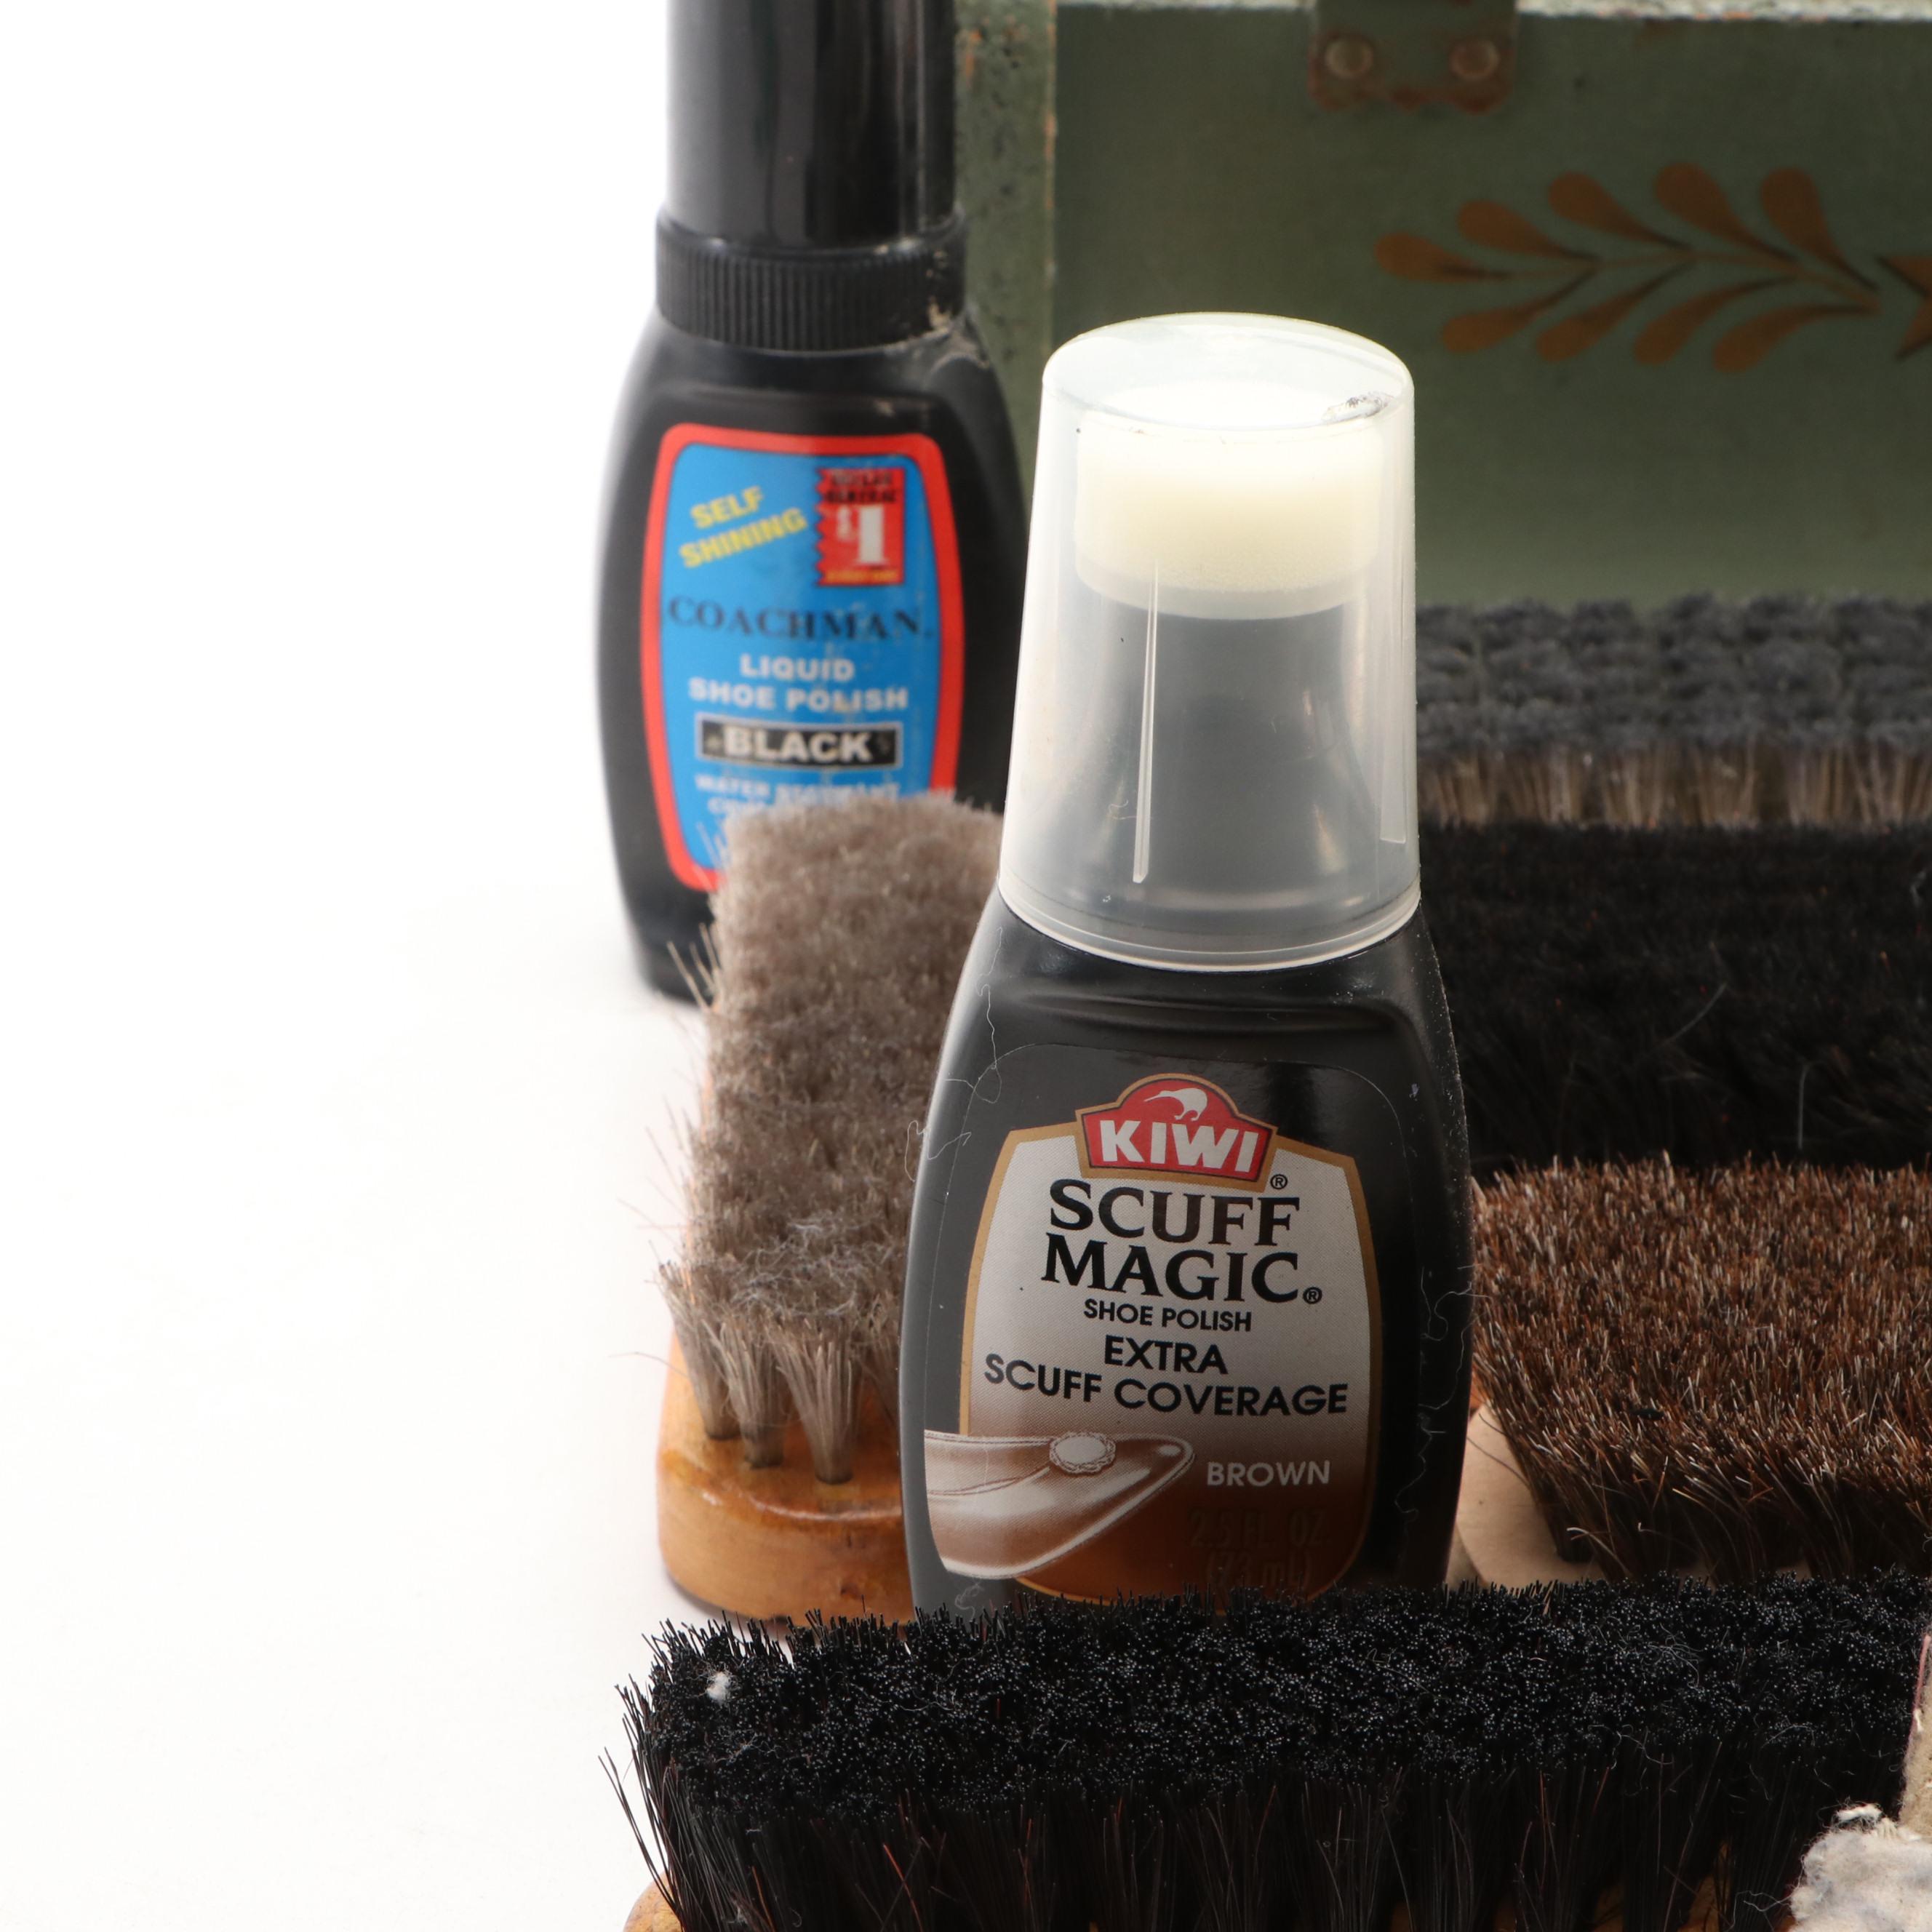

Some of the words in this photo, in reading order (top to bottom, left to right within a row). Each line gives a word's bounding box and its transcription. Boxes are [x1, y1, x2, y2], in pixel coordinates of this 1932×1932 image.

[690, 486, 763, 530] SELF
[679, 508, 807, 569] SHINING
[668, 594, 919, 642] COACHMAN
[739, 653, 855, 682] LIQUID
[688, 676, 776, 710] SHOE
[786, 687, 909, 714] POLISH
[723, 725, 873, 762] BLACK
[1100, 1119, 1259, 1173] KIWI
[1050, 1178, 1300, 1246] SCUFF
[1083, 1298, 1154, 1326] SHOE
[1161, 1307, 1252, 1333] POLISH
[1103, 1334, 1229, 1375] EXTRA
[984, 1353, 1103, 1402] SCUFF
[1114, 1378, 1349, 1416] COVERAGE
[1206, 1459, 1331, 1487] BROWN
